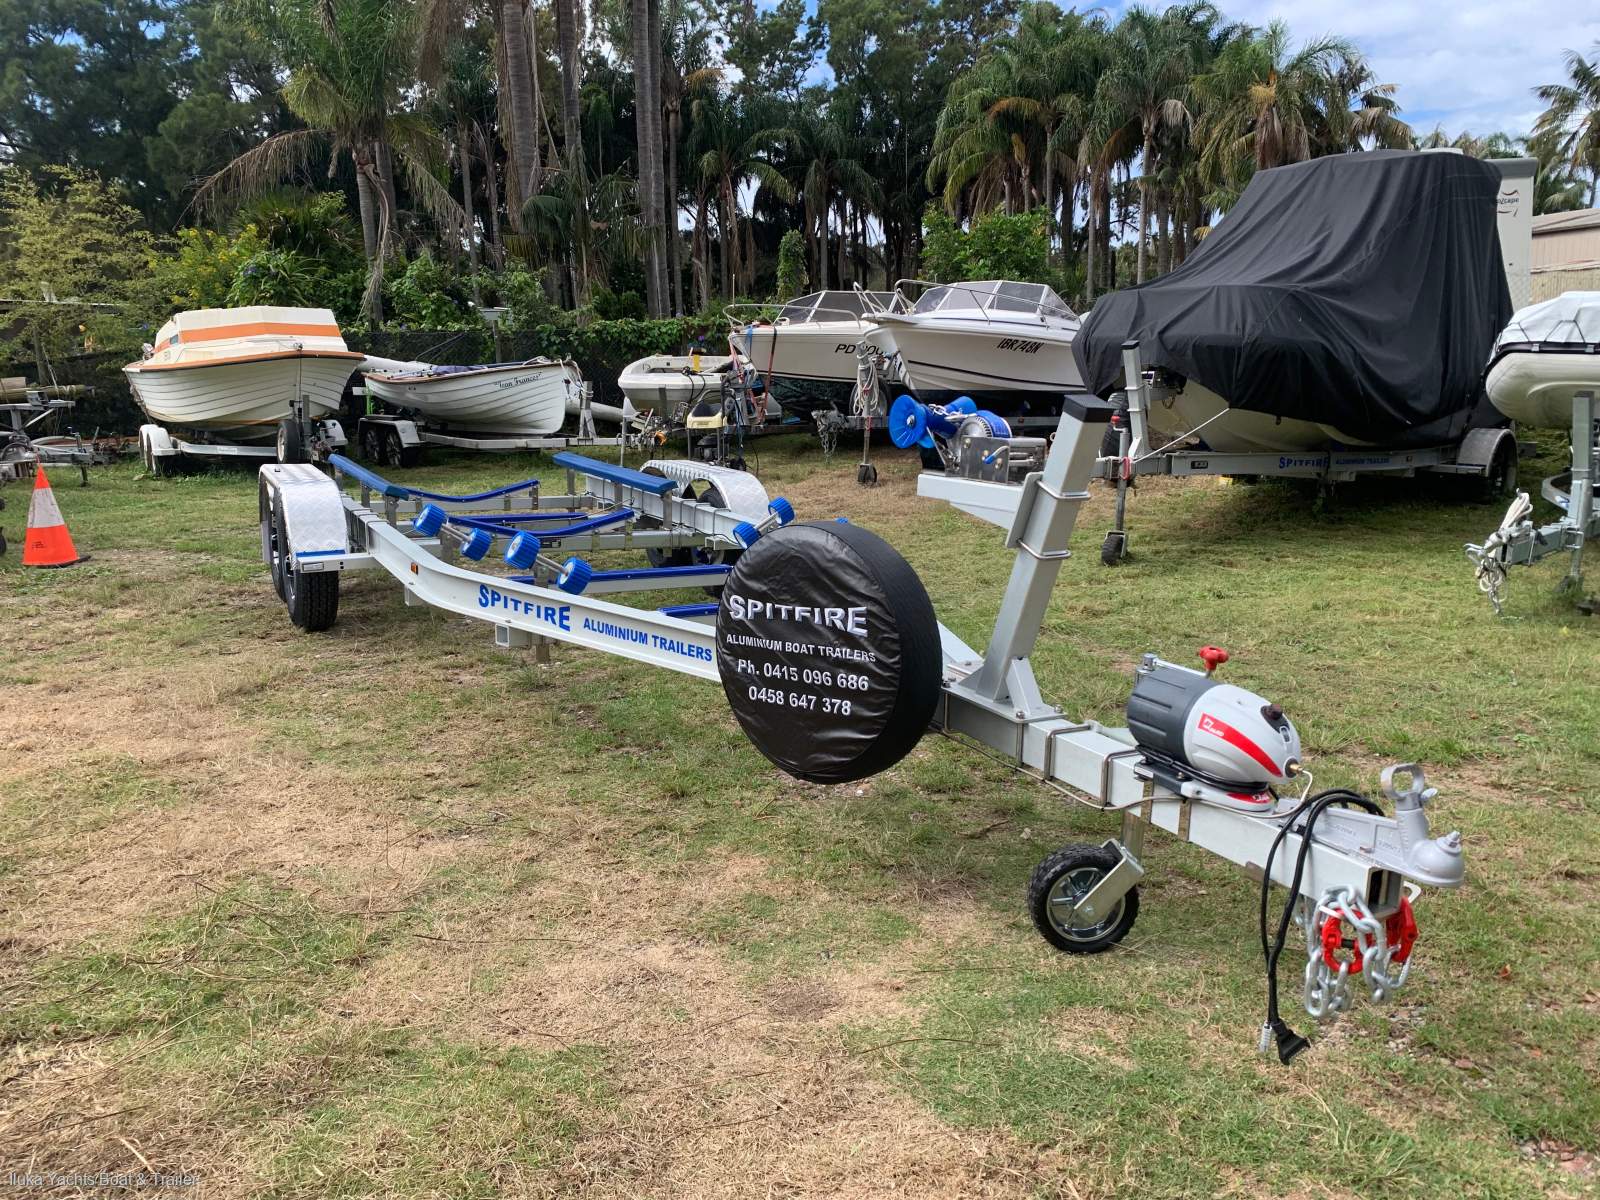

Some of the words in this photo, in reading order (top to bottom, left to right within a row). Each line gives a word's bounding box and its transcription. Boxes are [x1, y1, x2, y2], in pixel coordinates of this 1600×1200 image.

[478, 584, 571, 632] SPITFIRE
[583, 617, 648, 645] ALUMINIUM
[652, 635, 713, 662] TRAILERS
[729, 594, 868, 638] SPITFIRE
[726, 633, 783, 651] ALUMINIUM
[785, 641, 815, 655] BOAT
[818, 645, 876, 663] TRAILERS
[737, 658, 760, 676] Ph.
[763, 662, 799, 682] 0415
[803, 669, 832, 687] 096
[837, 673, 870, 692] 686
[748, 685, 784, 705] 0458
[789, 692, 817, 711] 647
[822, 697, 852, 716] 378
